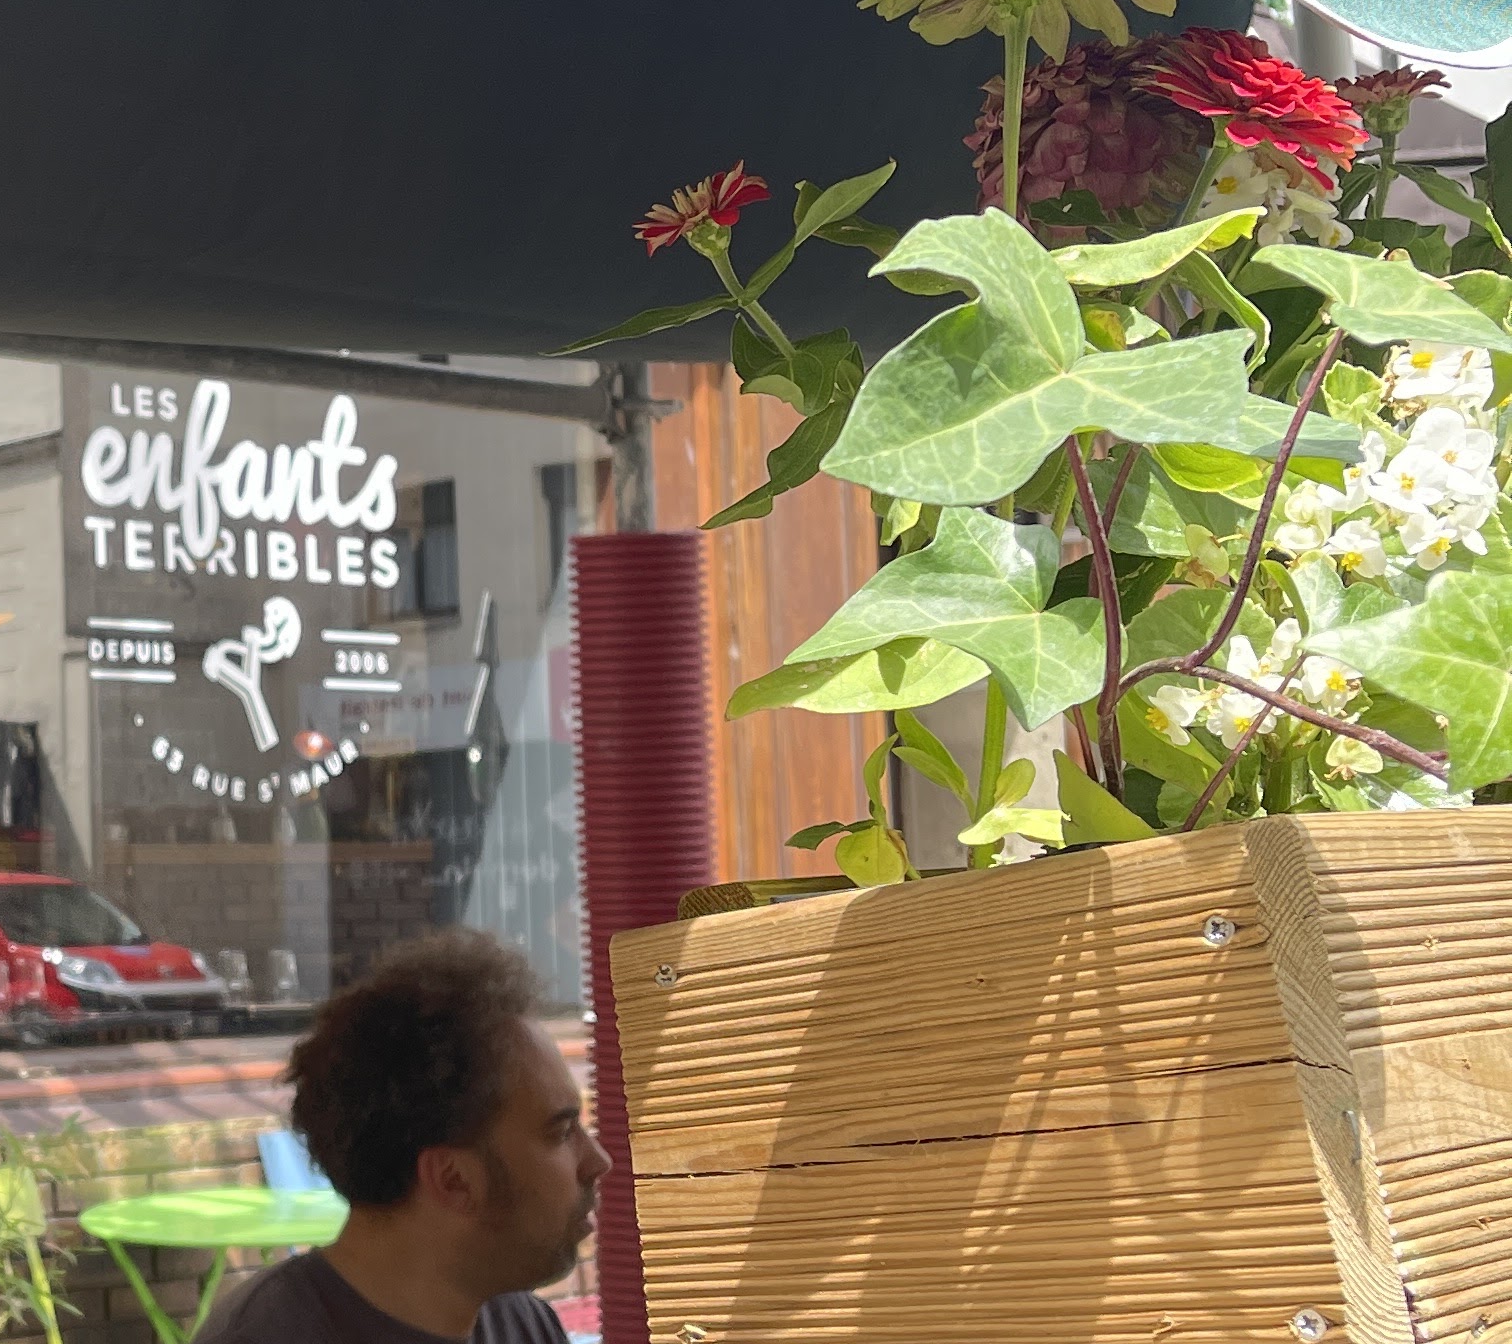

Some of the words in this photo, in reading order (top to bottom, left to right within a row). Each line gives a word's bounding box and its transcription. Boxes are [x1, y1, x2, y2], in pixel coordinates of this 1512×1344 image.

[110, 382, 179, 423] LES
[81, 378, 399, 558] enfants
[84, 516, 401, 590] TERRIBLES
[88, 640, 176, 666] DEPUIS
[334, 650, 390, 675] 2006
[151, 735, 184, 774] 63
[192, 763, 246, 802] RUE
[289, 738, 359, 797] MAUR
